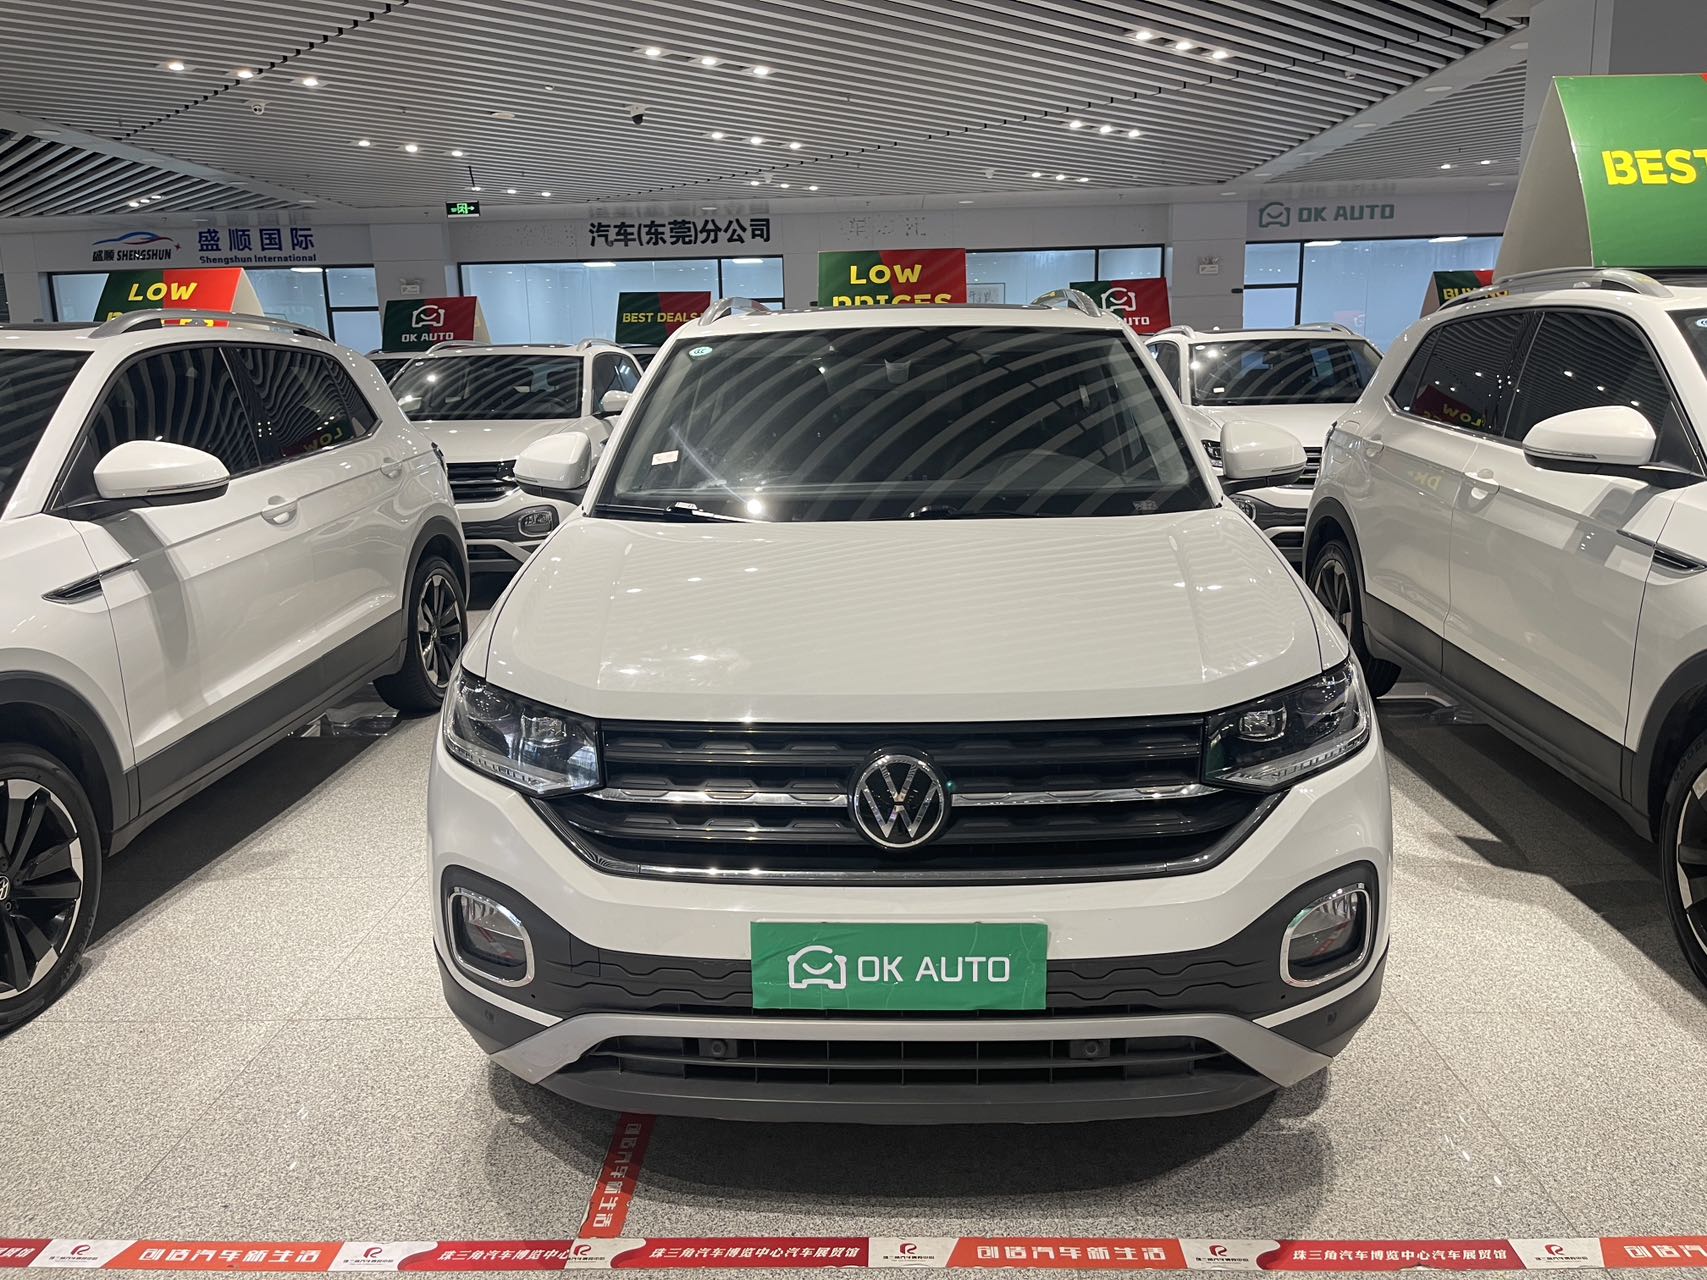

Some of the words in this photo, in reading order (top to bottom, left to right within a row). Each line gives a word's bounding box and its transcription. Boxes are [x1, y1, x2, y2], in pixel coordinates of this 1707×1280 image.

[1298, 206, 1327, 222] OK
[1333, 204, 1395, 221] AUTO
[198, 228, 315, 251] 盛顺国际
[589, 218, 770, 247] 汽车(东莞)分公司
[199, 255, 252, 265] Shengshun
[254, 253, 317, 263] International
[849, 264, 922, 284] LOW
[128, 282, 198, 301] LOW
[622, 312, 654, 323] BEST
[401, 333, 418, 342] OK
[420, 332, 454, 342] AUTO
[857, 956, 903, 982] OK
[915, 956, 1010, 982] AUTO
